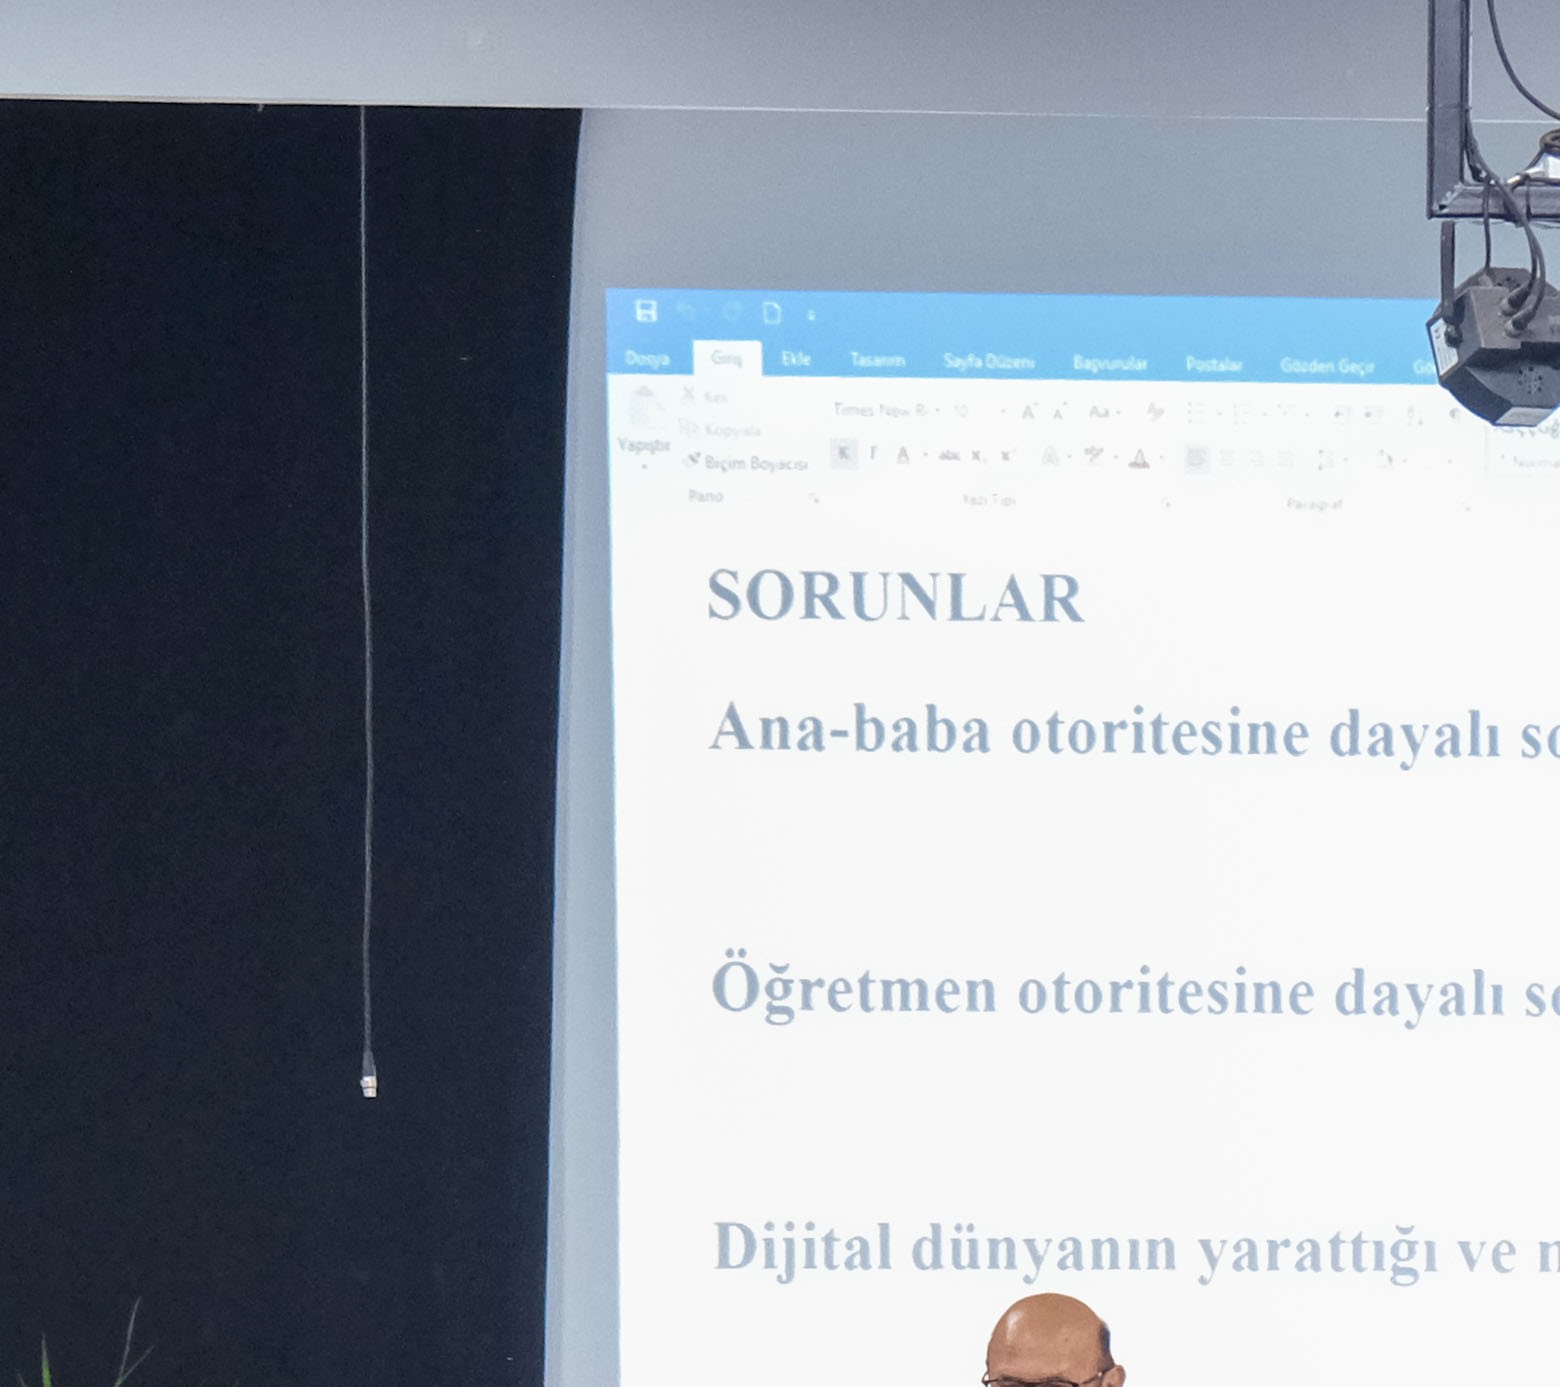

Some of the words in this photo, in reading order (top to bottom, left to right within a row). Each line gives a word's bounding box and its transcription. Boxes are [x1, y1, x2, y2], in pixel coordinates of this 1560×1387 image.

[625, 350, 671, 369] Dosya
[781, 351, 812, 367] Ekle
[851, 352, 907, 368] Tasarım
[943, 352, 982, 371] Sayfa
[985, 353, 1036, 370] Düzeni
[1073, 354, 1148, 374] Başvurular
[1186, 355, 1244, 372] Postalar
[1280, 356, 1336, 375] Gözden
[708, 568, 1085, 623] SORUNLAR
[709, 701, 991, 754] Ana-baba
[1012, 705, 1309, 757] otoritesine
[1330, 708, 1500, 771] dayalı
[712, 948, 996, 1026] Öğretmen
[1019, 965, 1315, 1015] otoritesine
[1335, 968, 1504, 1030] dayalı
[714, 1221, 892, 1284] Dijital
[912, 1223, 1176, 1285] dünyanın
[1198, 1225, 1437, 1286] yarattığı
[1458, 1240, 1516, 1273] ve
